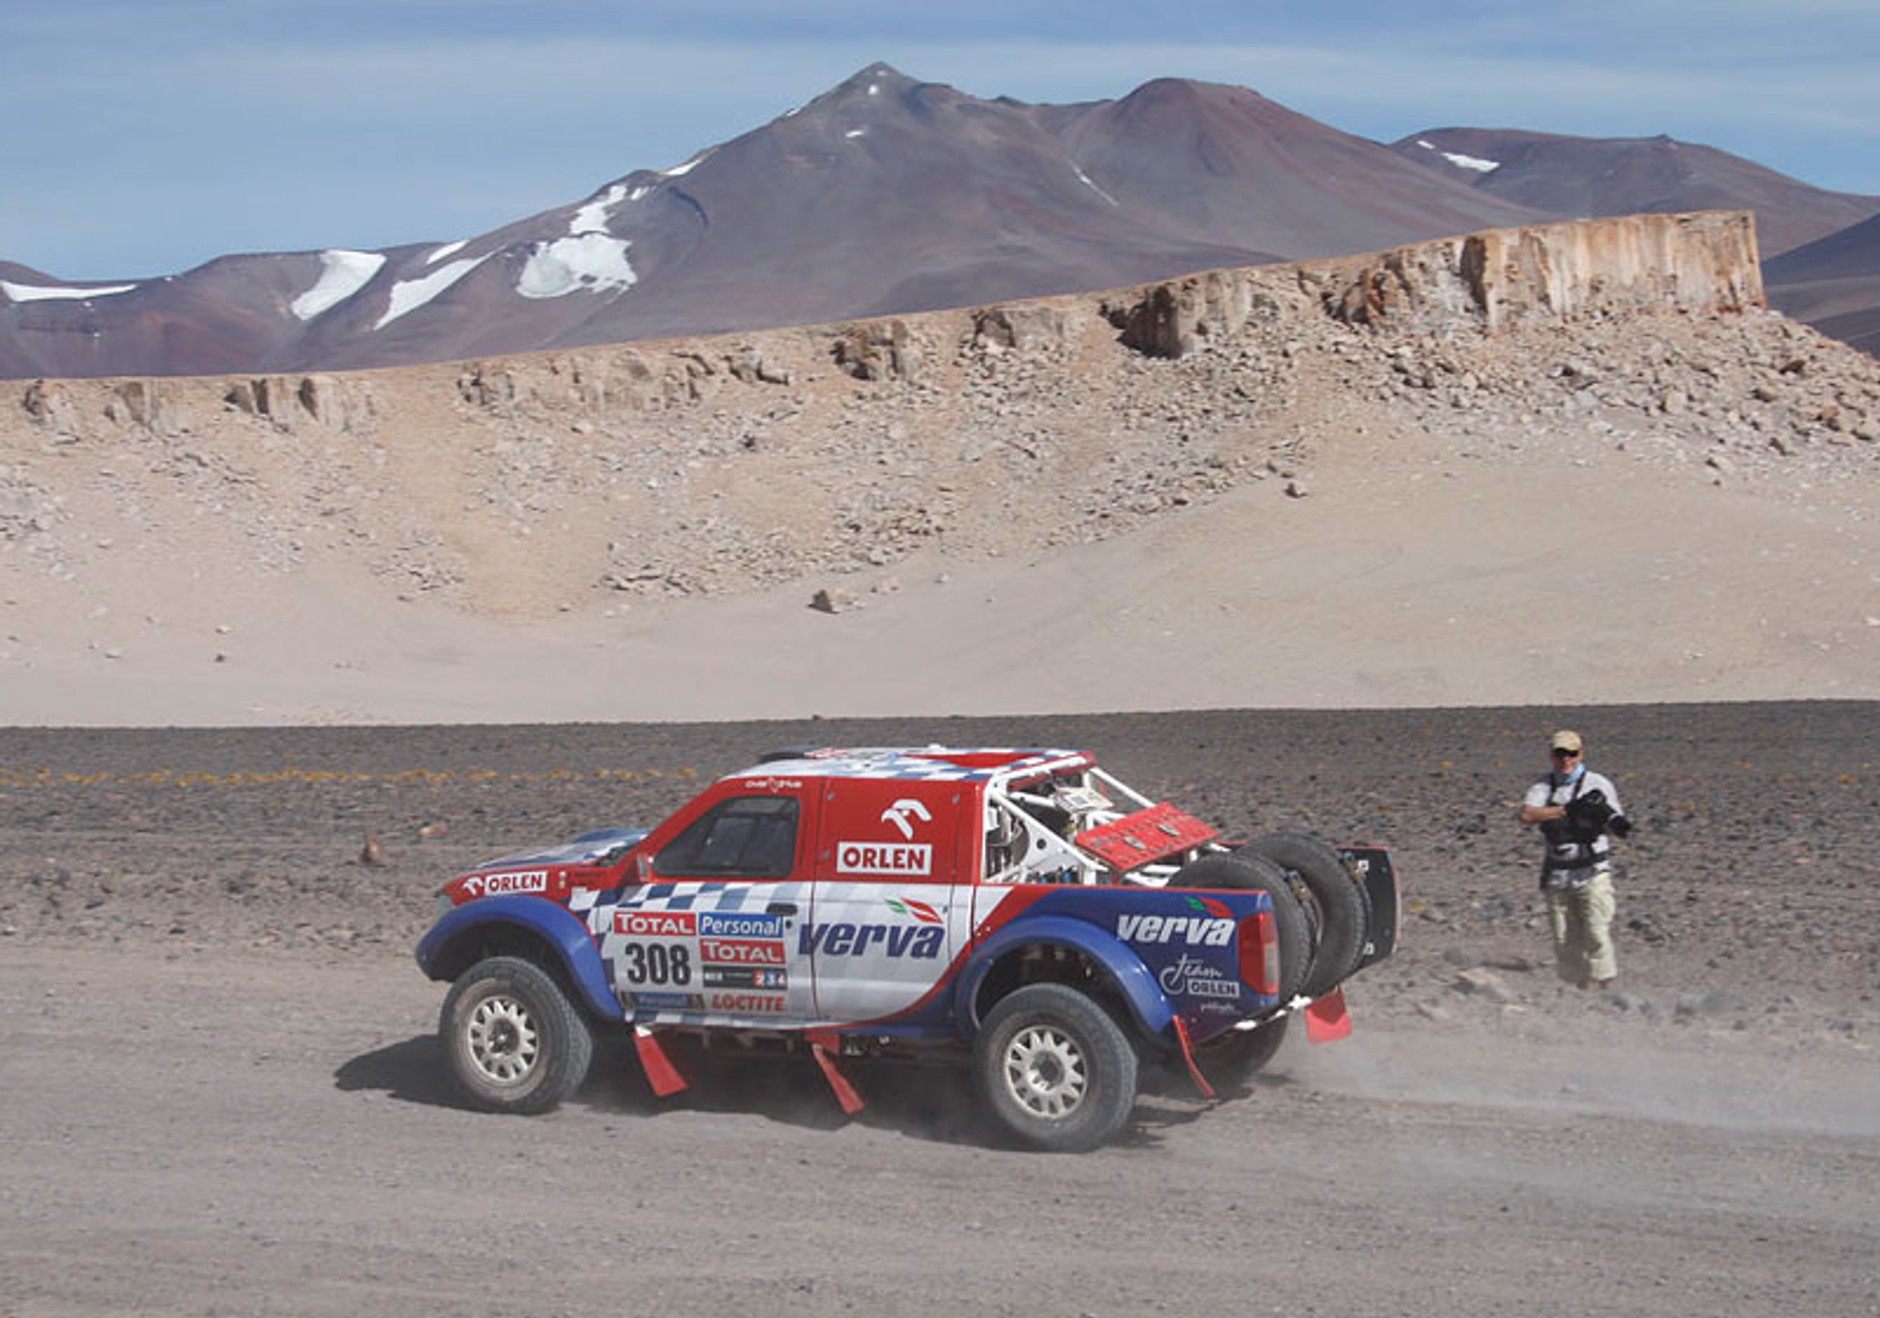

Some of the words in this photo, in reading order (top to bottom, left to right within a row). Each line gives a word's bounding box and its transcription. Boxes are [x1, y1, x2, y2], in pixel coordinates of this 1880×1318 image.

[843, 847, 925, 870] ORLEN
[489, 874, 542, 892] ORLEN
[701, 915, 780, 935] Personal
[1117, 914, 1236, 946] verva
[798, 923, 946, 960] verva
[625, 942, 691, 986] 308
[1190, 981, 1238, 996] ORLEN
[711, 995, 785, 1012] LOCTITE
